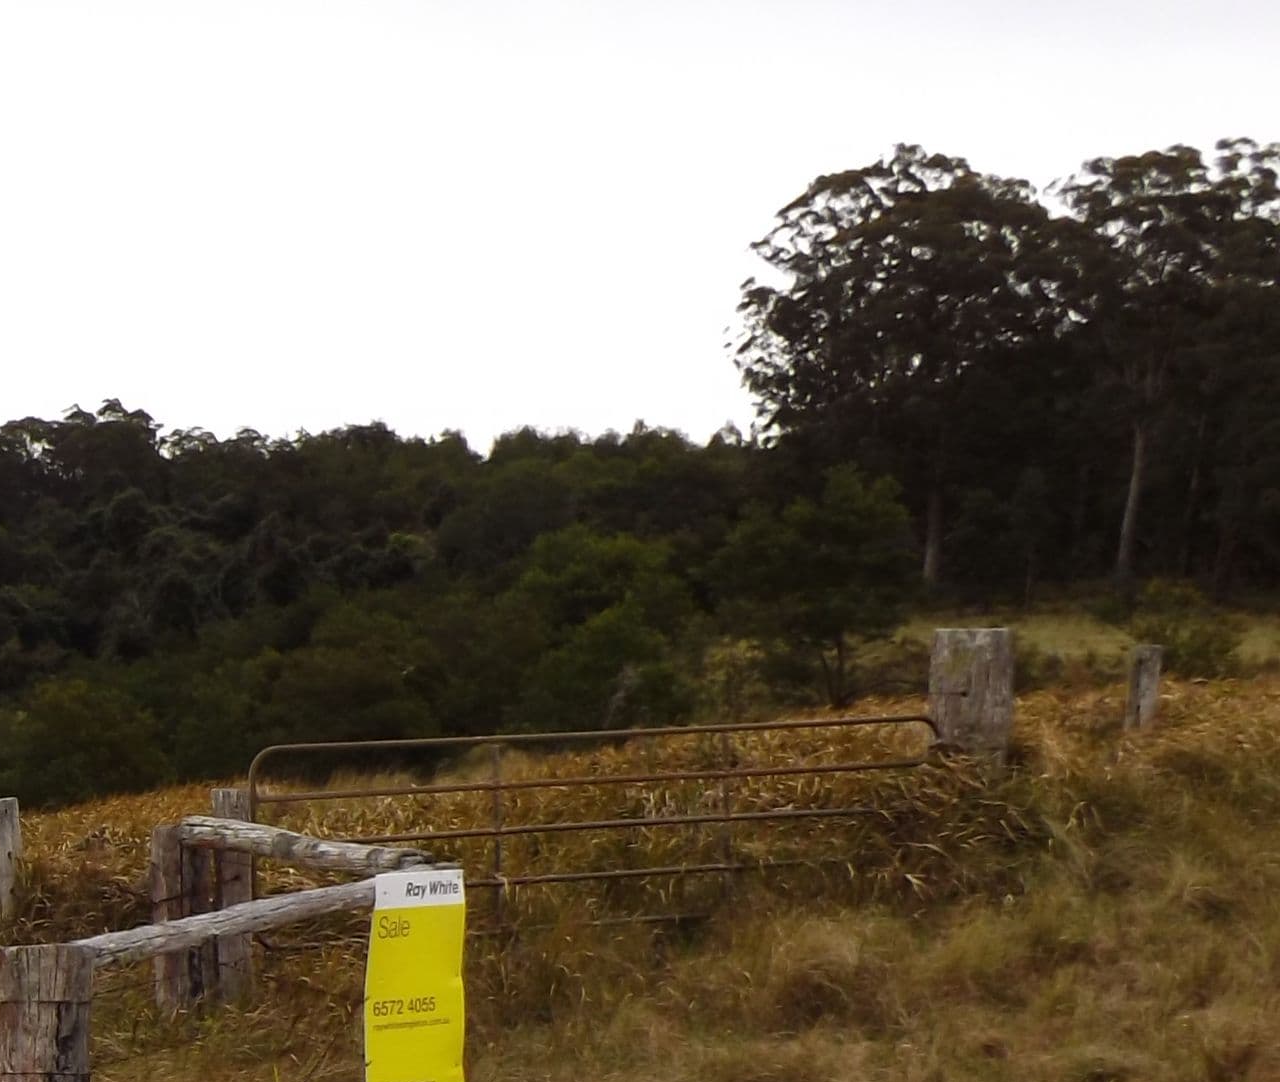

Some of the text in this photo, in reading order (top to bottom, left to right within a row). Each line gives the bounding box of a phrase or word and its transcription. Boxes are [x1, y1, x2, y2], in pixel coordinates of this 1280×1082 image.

[405, 880, 459, 899] Ray White
[378, 915, 410, 939] Sale
[372, 996, 436, 1016] 6572 4055
